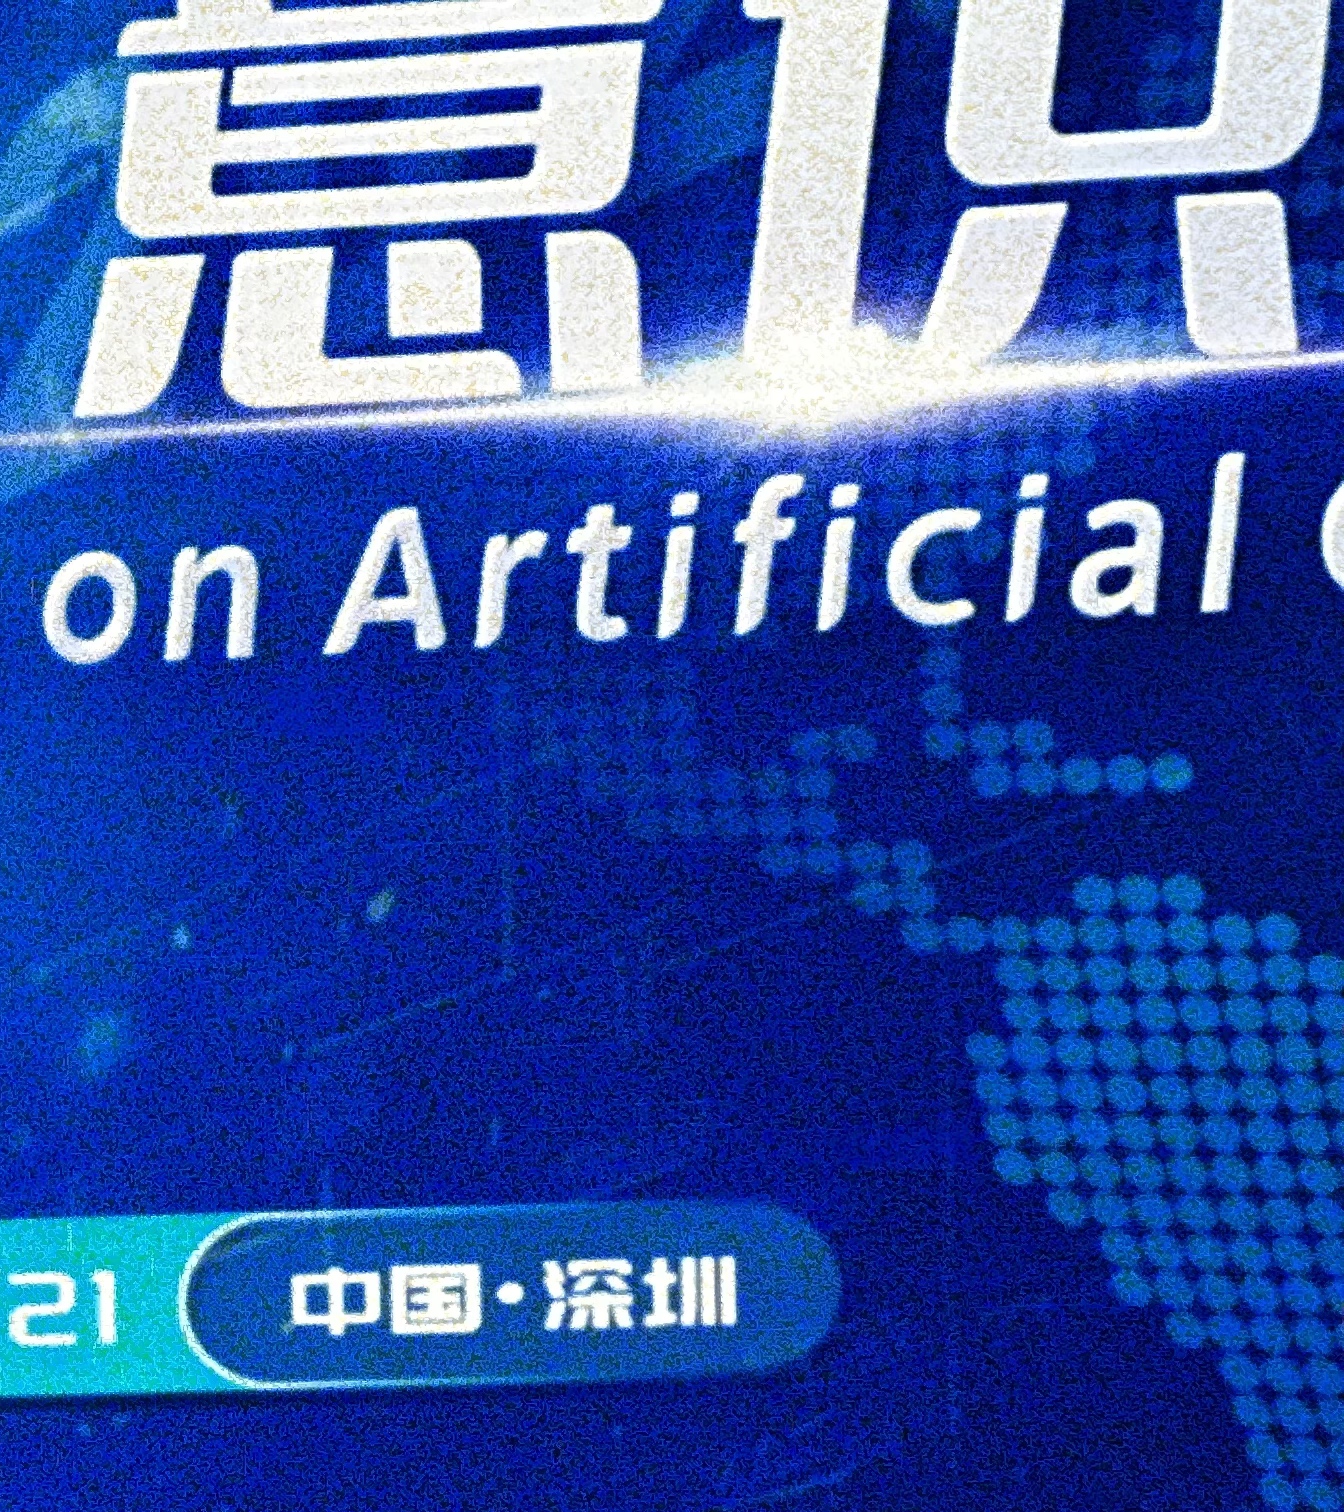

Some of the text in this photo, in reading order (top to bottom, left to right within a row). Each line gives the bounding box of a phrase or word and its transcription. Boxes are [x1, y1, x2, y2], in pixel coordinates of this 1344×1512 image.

[42, 545, 259, 664] on
[322, 452, 1246, 655] Artificial
[289, 1254, 739, 1337] 中国·深圳
